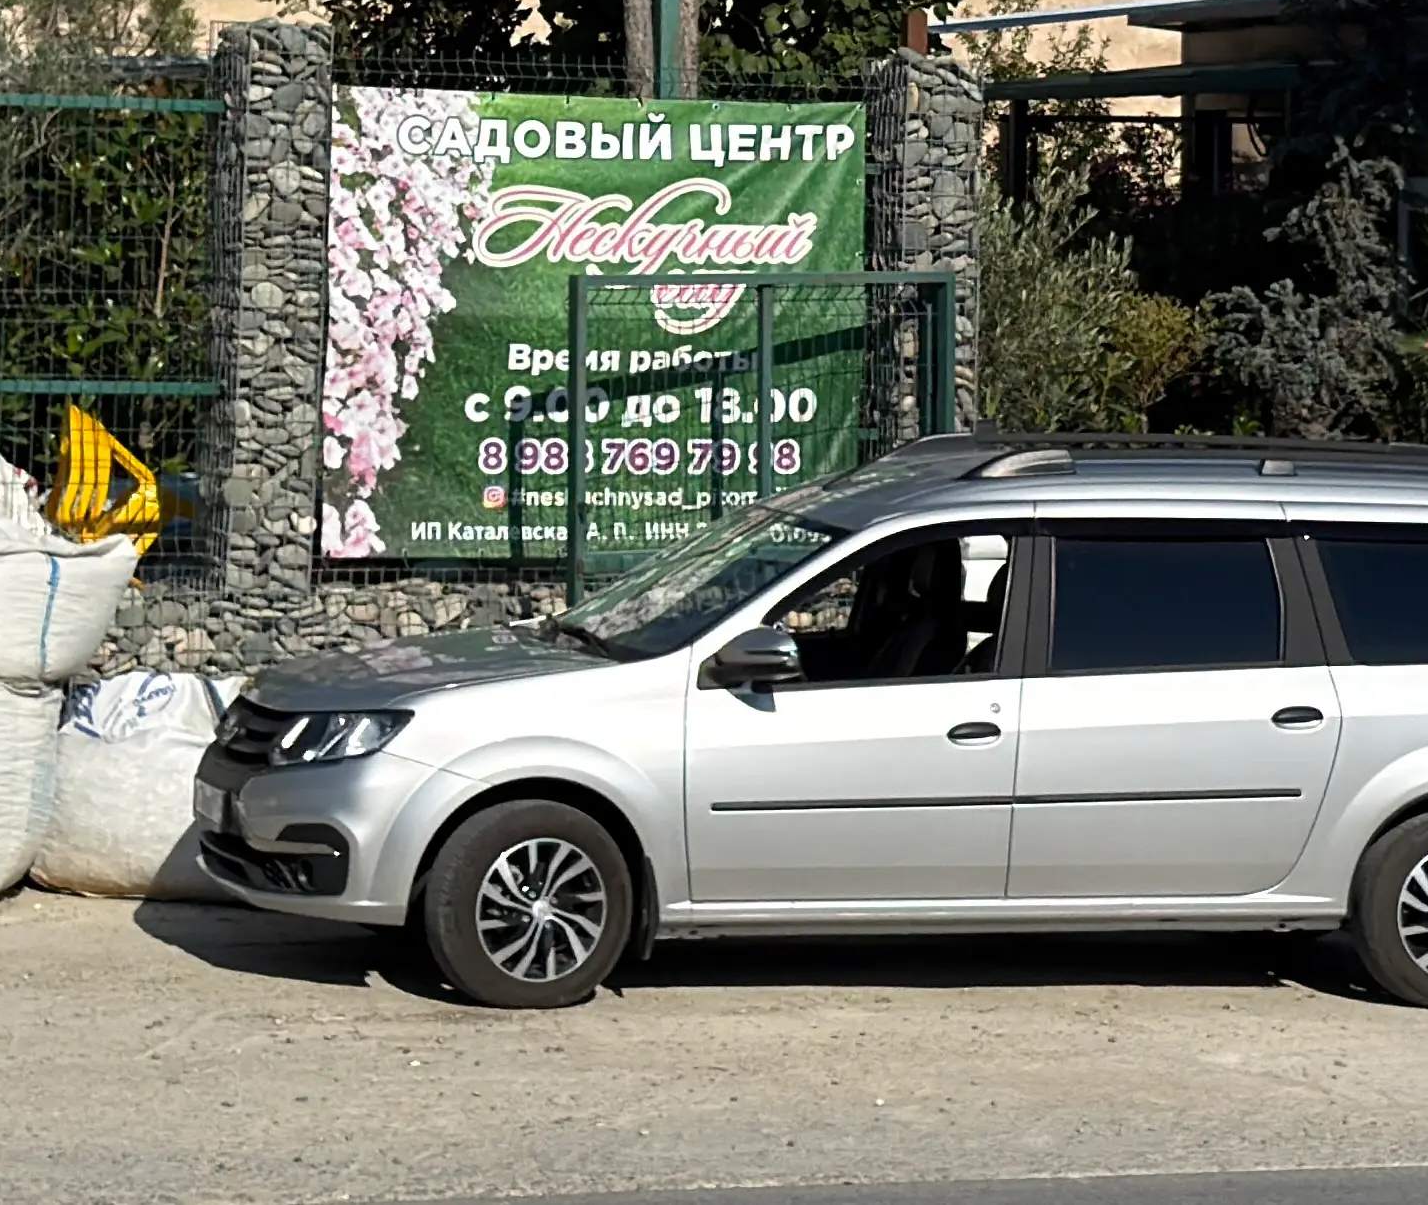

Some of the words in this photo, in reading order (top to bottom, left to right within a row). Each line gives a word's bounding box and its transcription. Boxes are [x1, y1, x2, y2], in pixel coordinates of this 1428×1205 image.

[397, 112, 673, 164] САДОВЫЙ
[688, 124, 855, 168] ЦЕНТР
[474, 179, 816, 277] Нескучный
[629, 344, 759, 375] работы
[464, 392, 491, 423] с
[504, 385, 611, 423] 9.00
[621, 394, 681, 428] до
[478, 436, 508, 475] 8
[515, 437, 595, 475] 98
[601, 438, 680, 476] 769
[687, 438, 741, 476] 79
[411, 521, 442, 541] ИП
[448, 521, 569, 541] Каталевска
